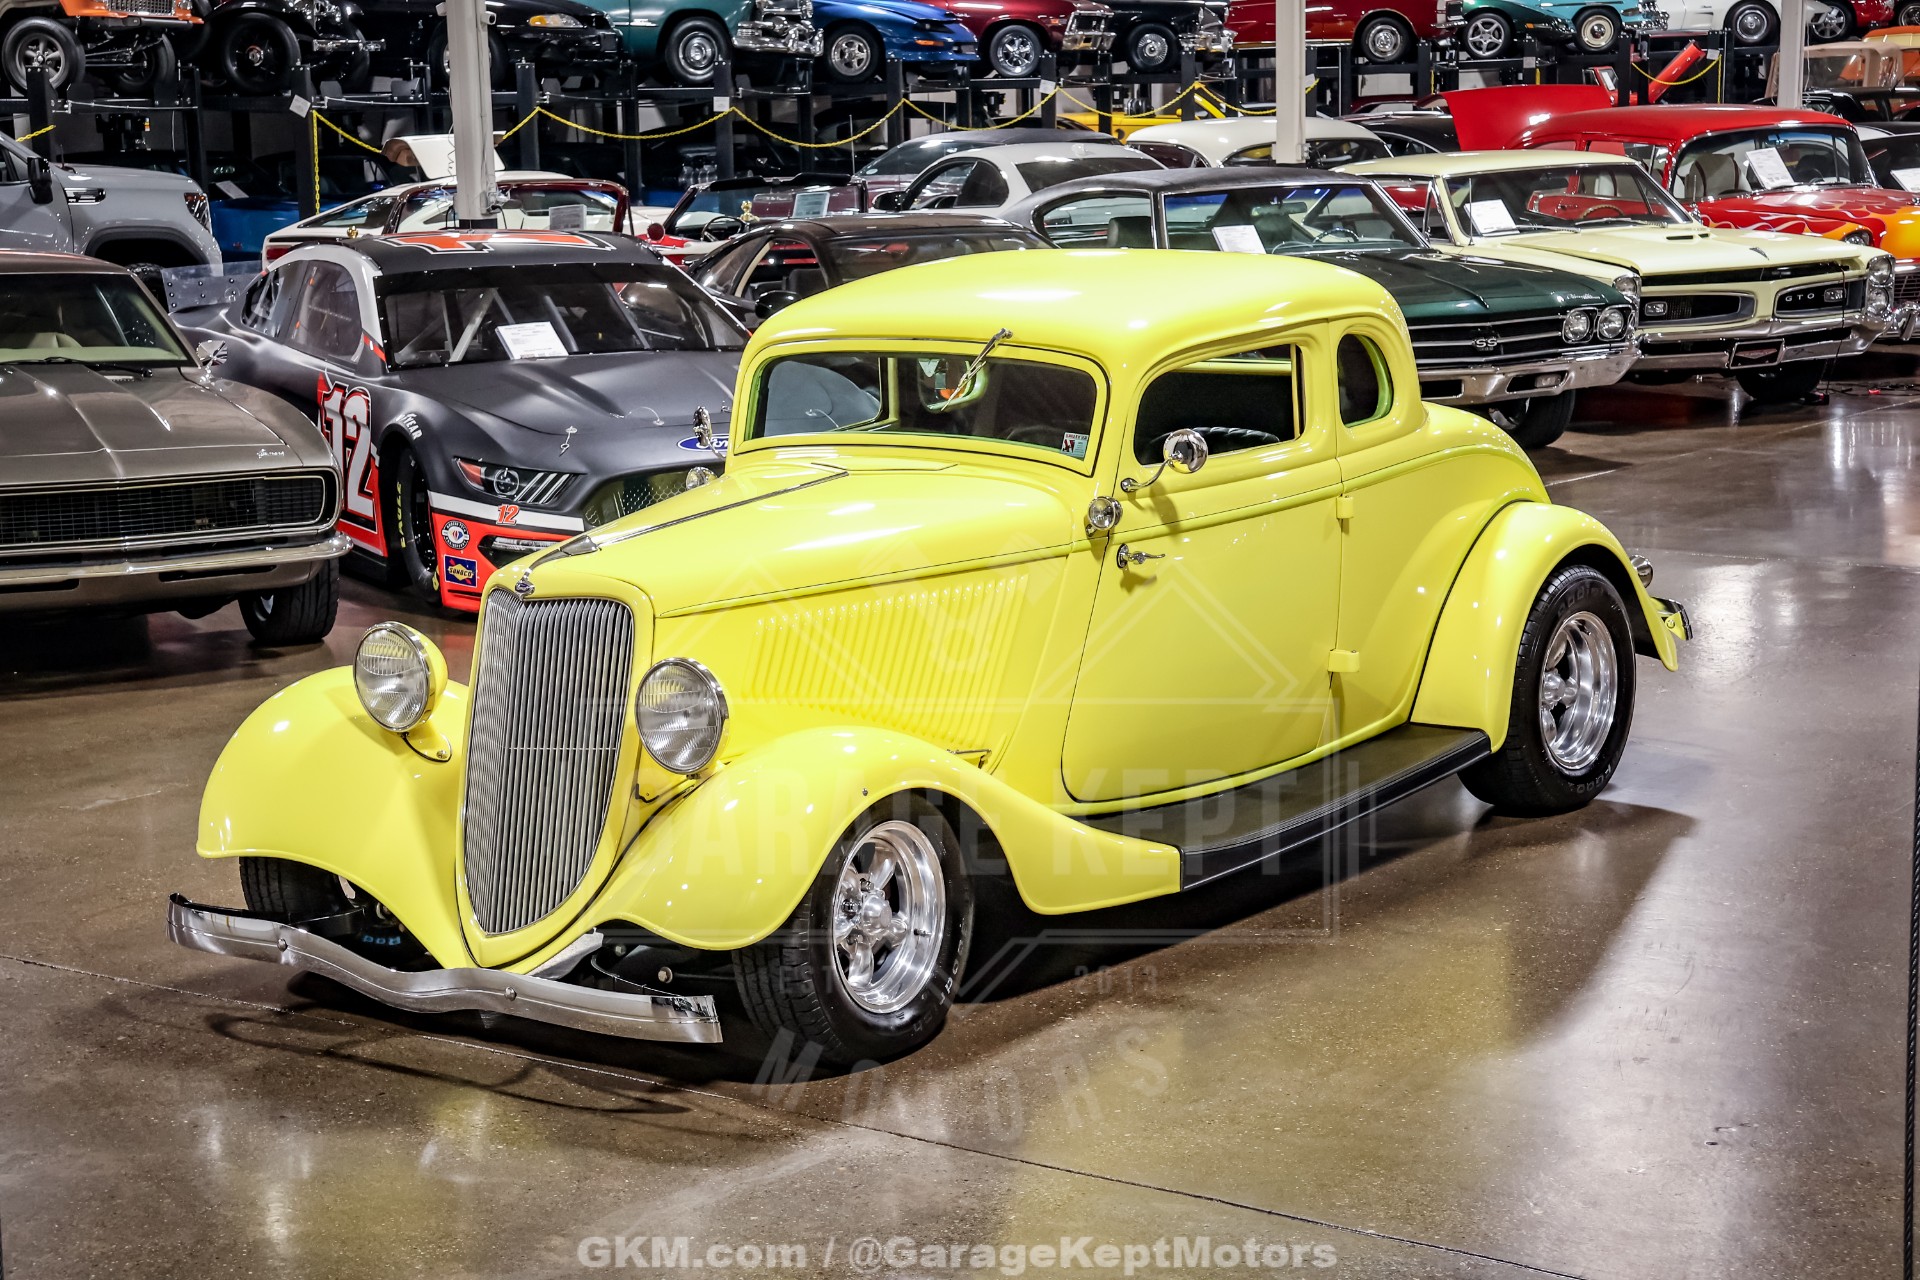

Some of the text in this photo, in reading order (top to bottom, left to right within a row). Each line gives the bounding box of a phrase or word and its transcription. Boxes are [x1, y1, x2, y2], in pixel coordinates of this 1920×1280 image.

[1785, 292, 1815, 302] GTO
[1475, 338, 1498, 348] SS
[322, 382, 376, 522] 12
[496, 504, 520, 525] 12
